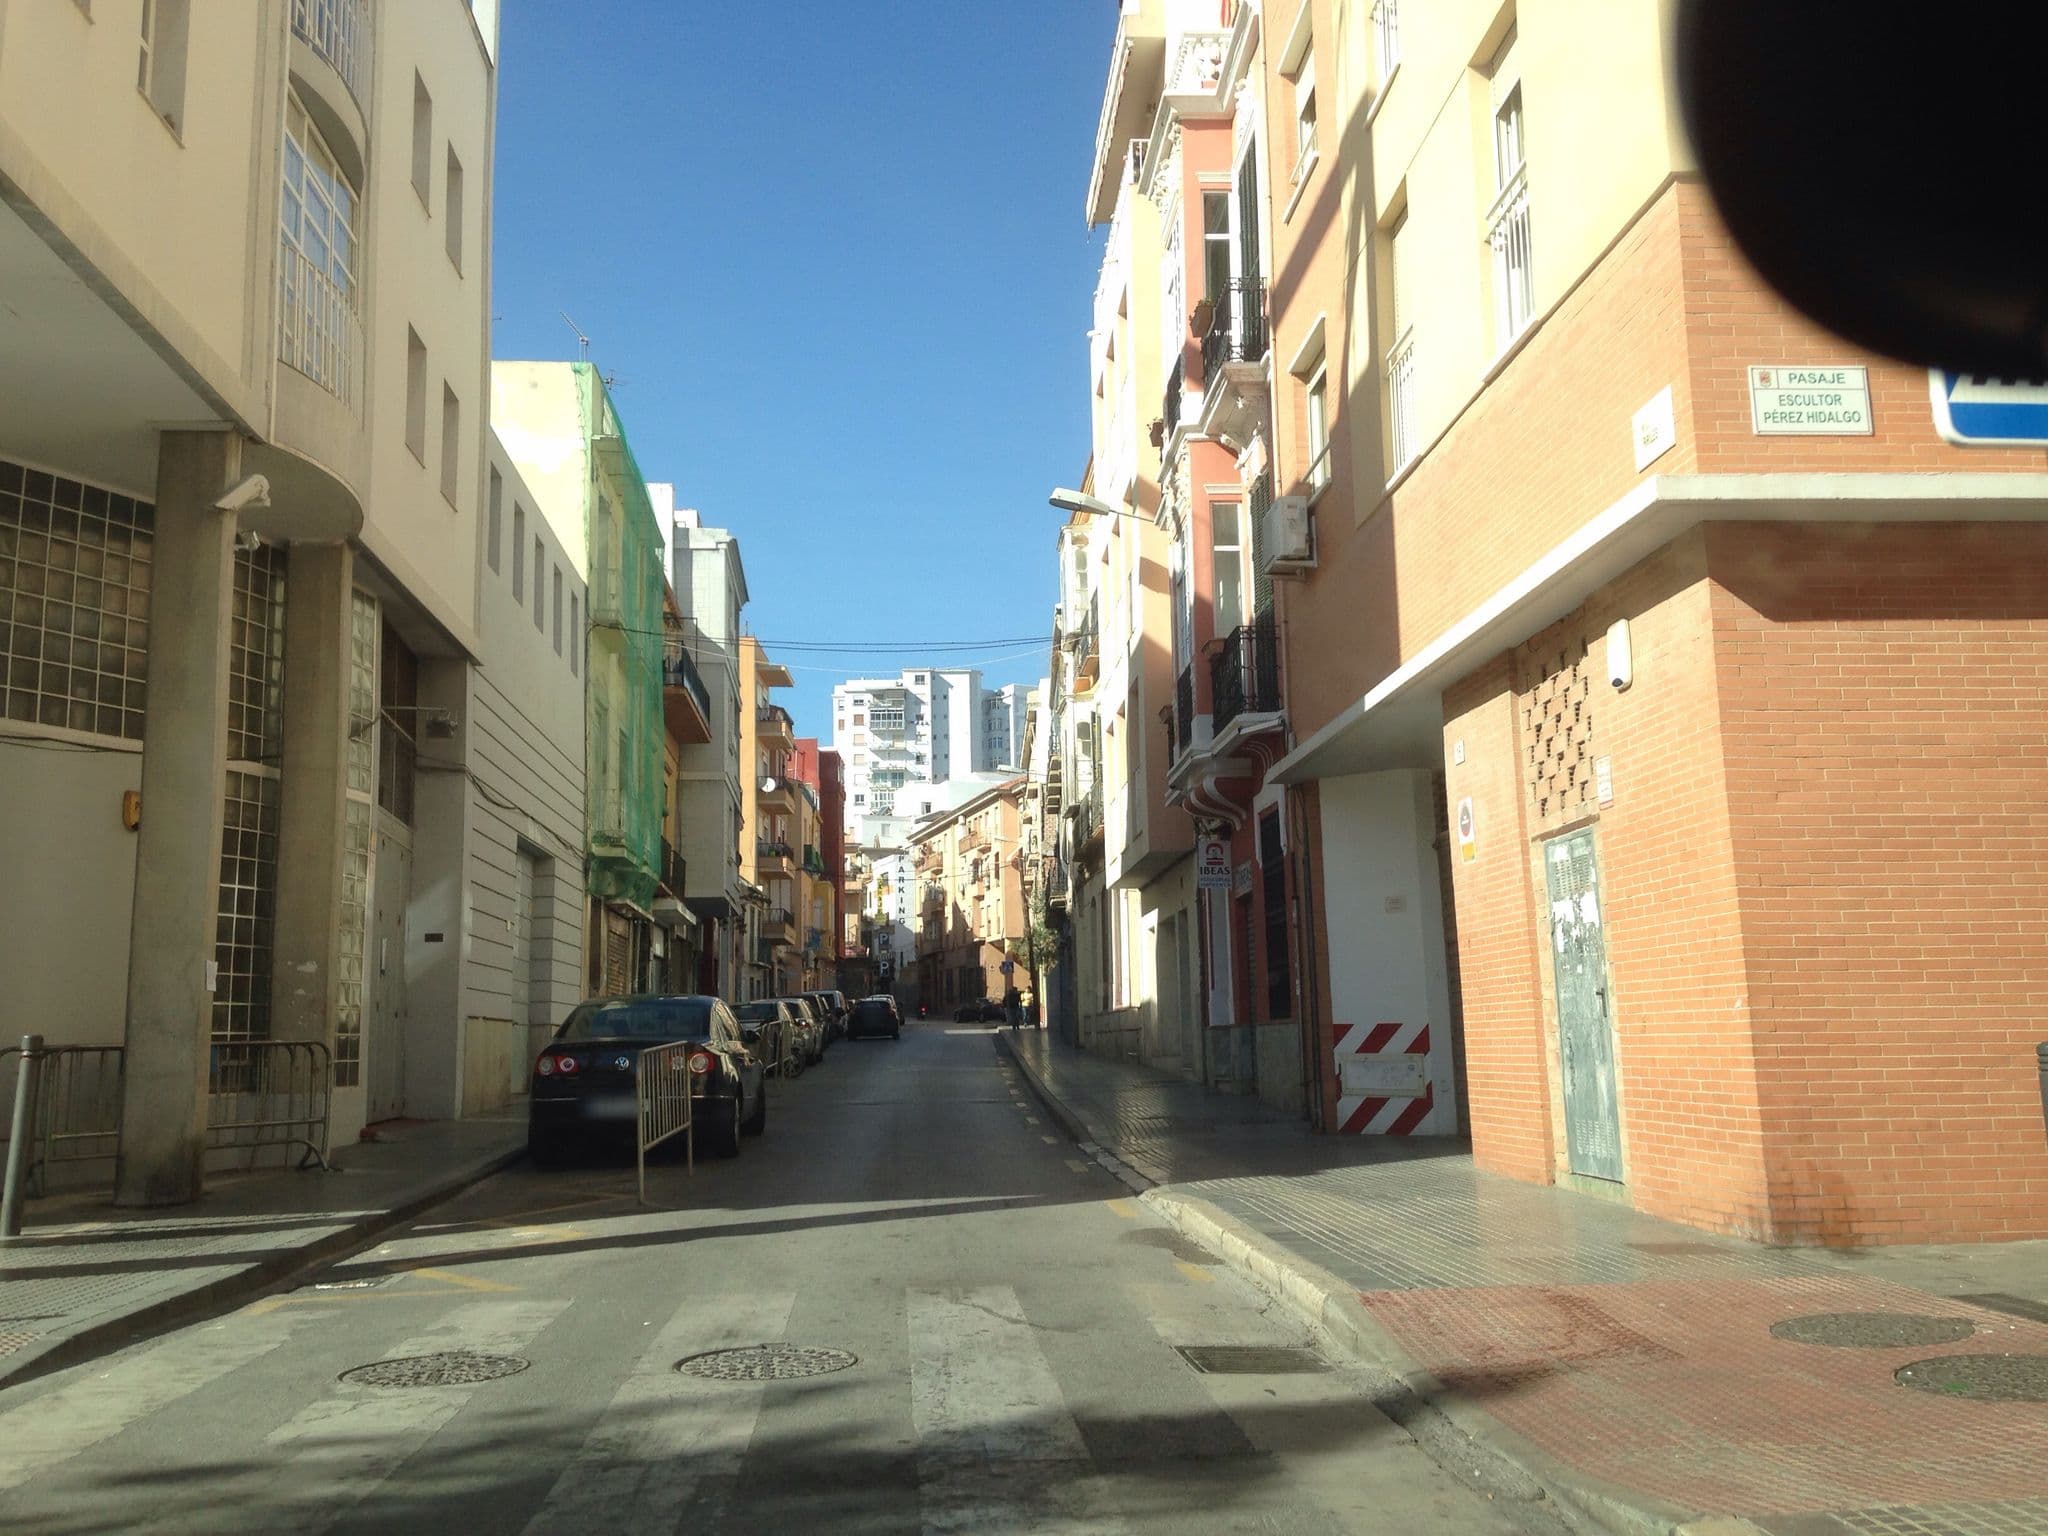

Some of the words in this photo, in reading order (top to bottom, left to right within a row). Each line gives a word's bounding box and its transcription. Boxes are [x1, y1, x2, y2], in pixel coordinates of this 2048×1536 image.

[1788, 373, 1846, 384] PASAJE
[1778, 394, 1842, 406] ESCULTOR
[1763, 409, 1804, 423] PÉREZ
[1806, 410, 1861, 423] HIDALGO
[1200, 866, 1230, 875] IBEAS
[880, 933, 889, 944] P
[880, 961, 889, 974] P
